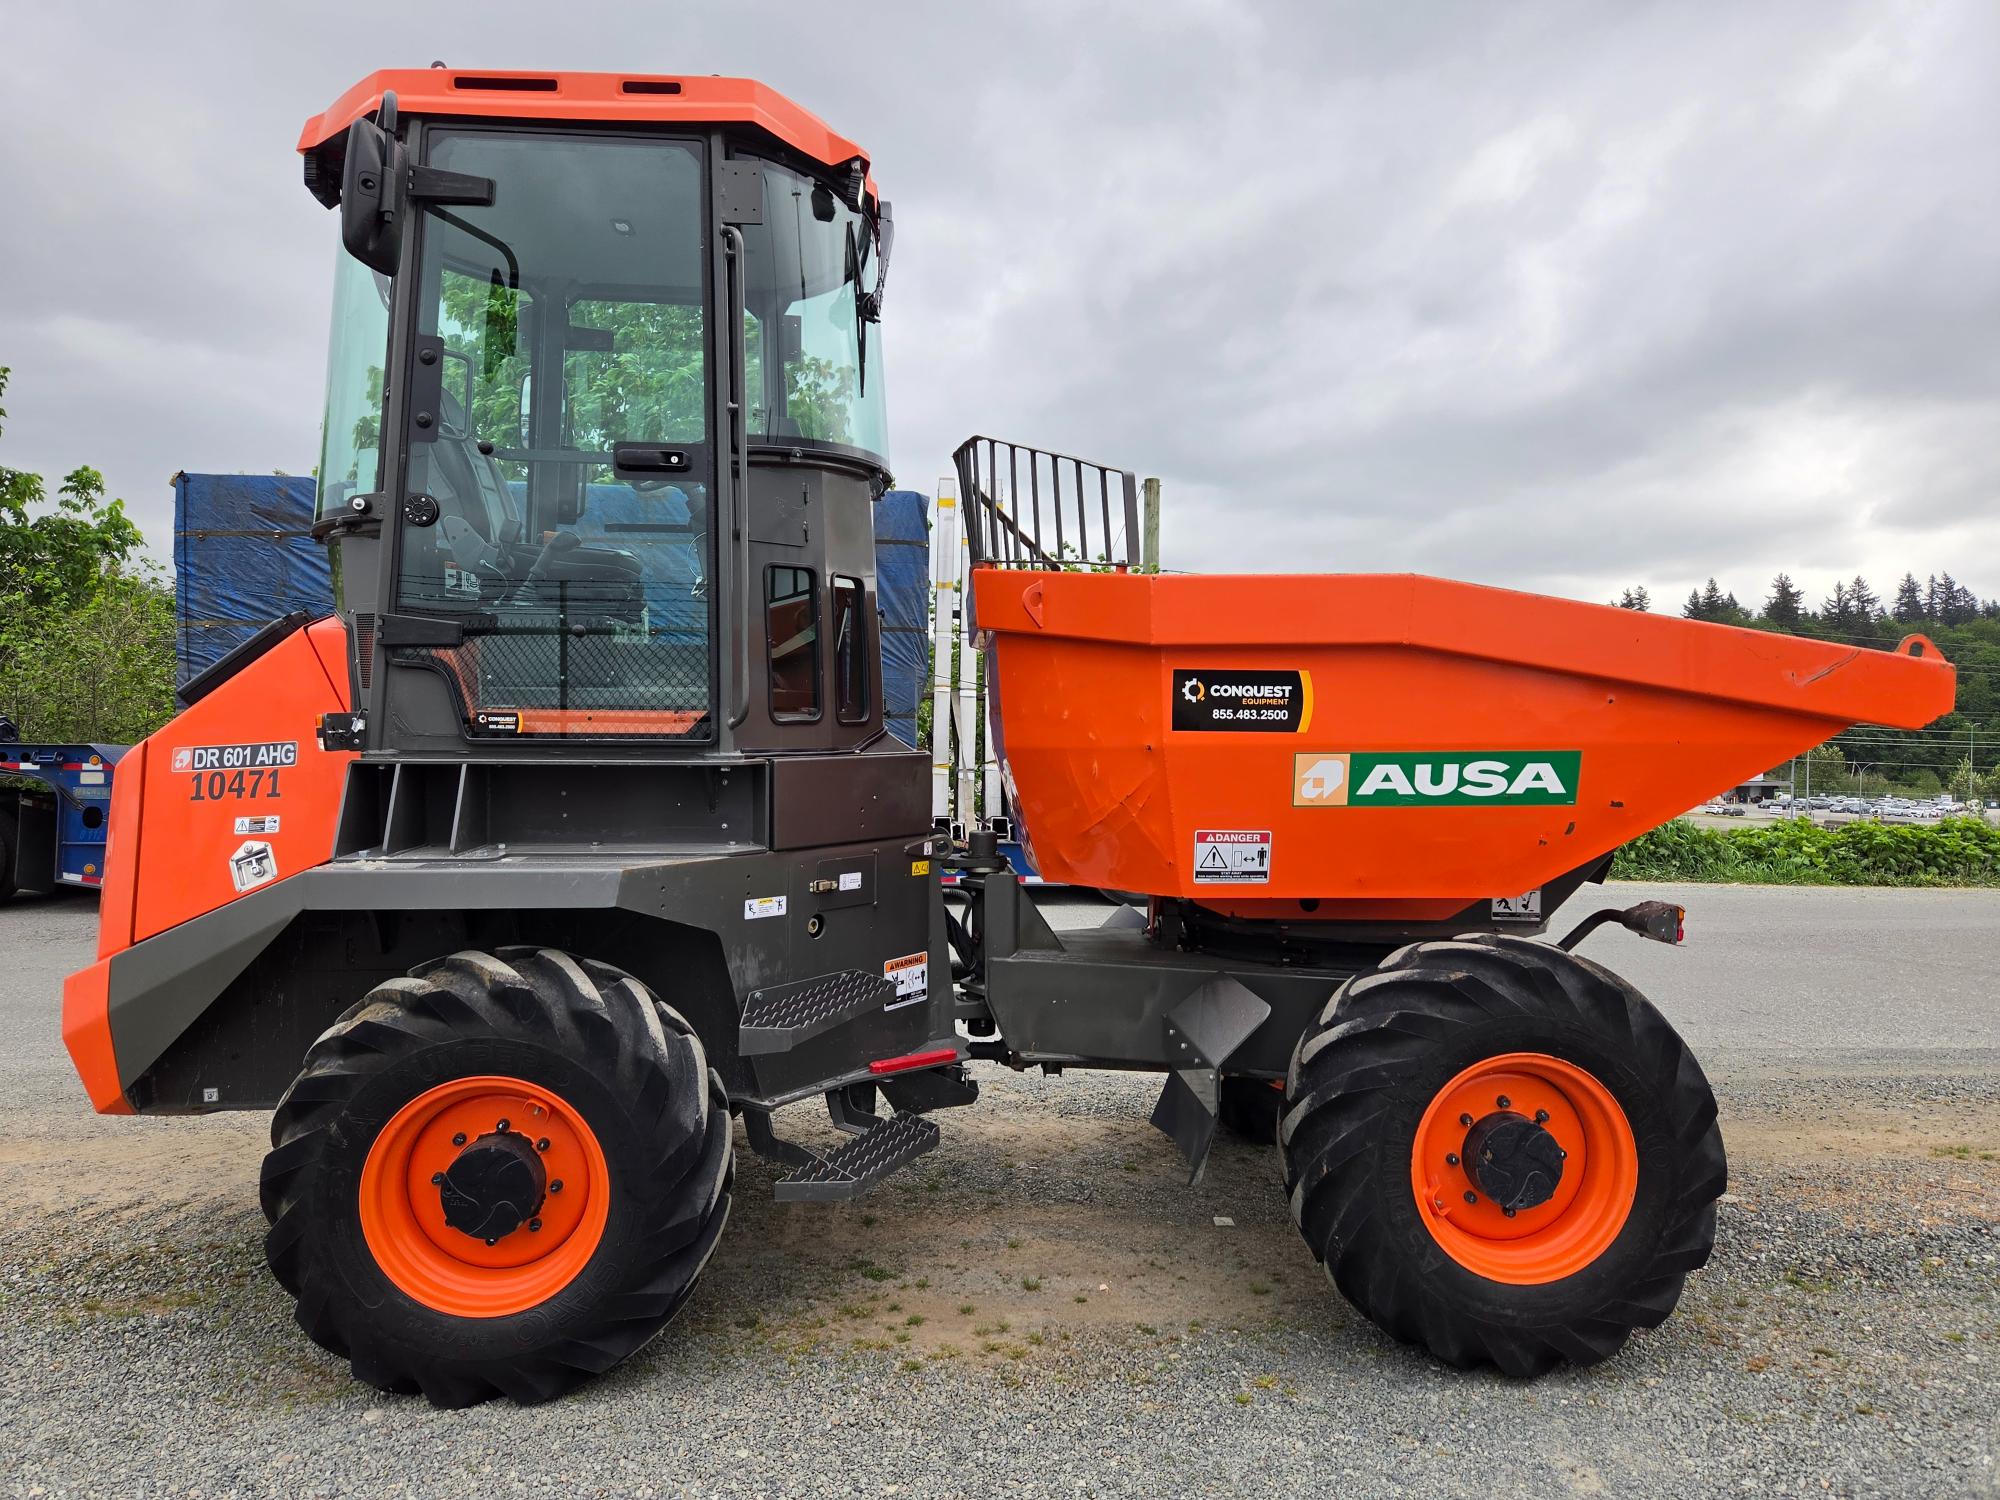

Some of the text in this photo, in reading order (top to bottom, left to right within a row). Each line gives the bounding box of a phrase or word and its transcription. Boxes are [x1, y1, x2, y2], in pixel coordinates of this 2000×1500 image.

[1210, 685, 1292, 697] CONQUEST
[1212, 709, 1289, 720] 855.483.2500
[194, 744, 295, 768] DR 601 AHG
[190, 769, 281, 801] 10471
[1355, 760, 1567, 796] AUSA
[1215, 833, 1261, 842] DANGER
[894, 955, 924, 970] WARNING
